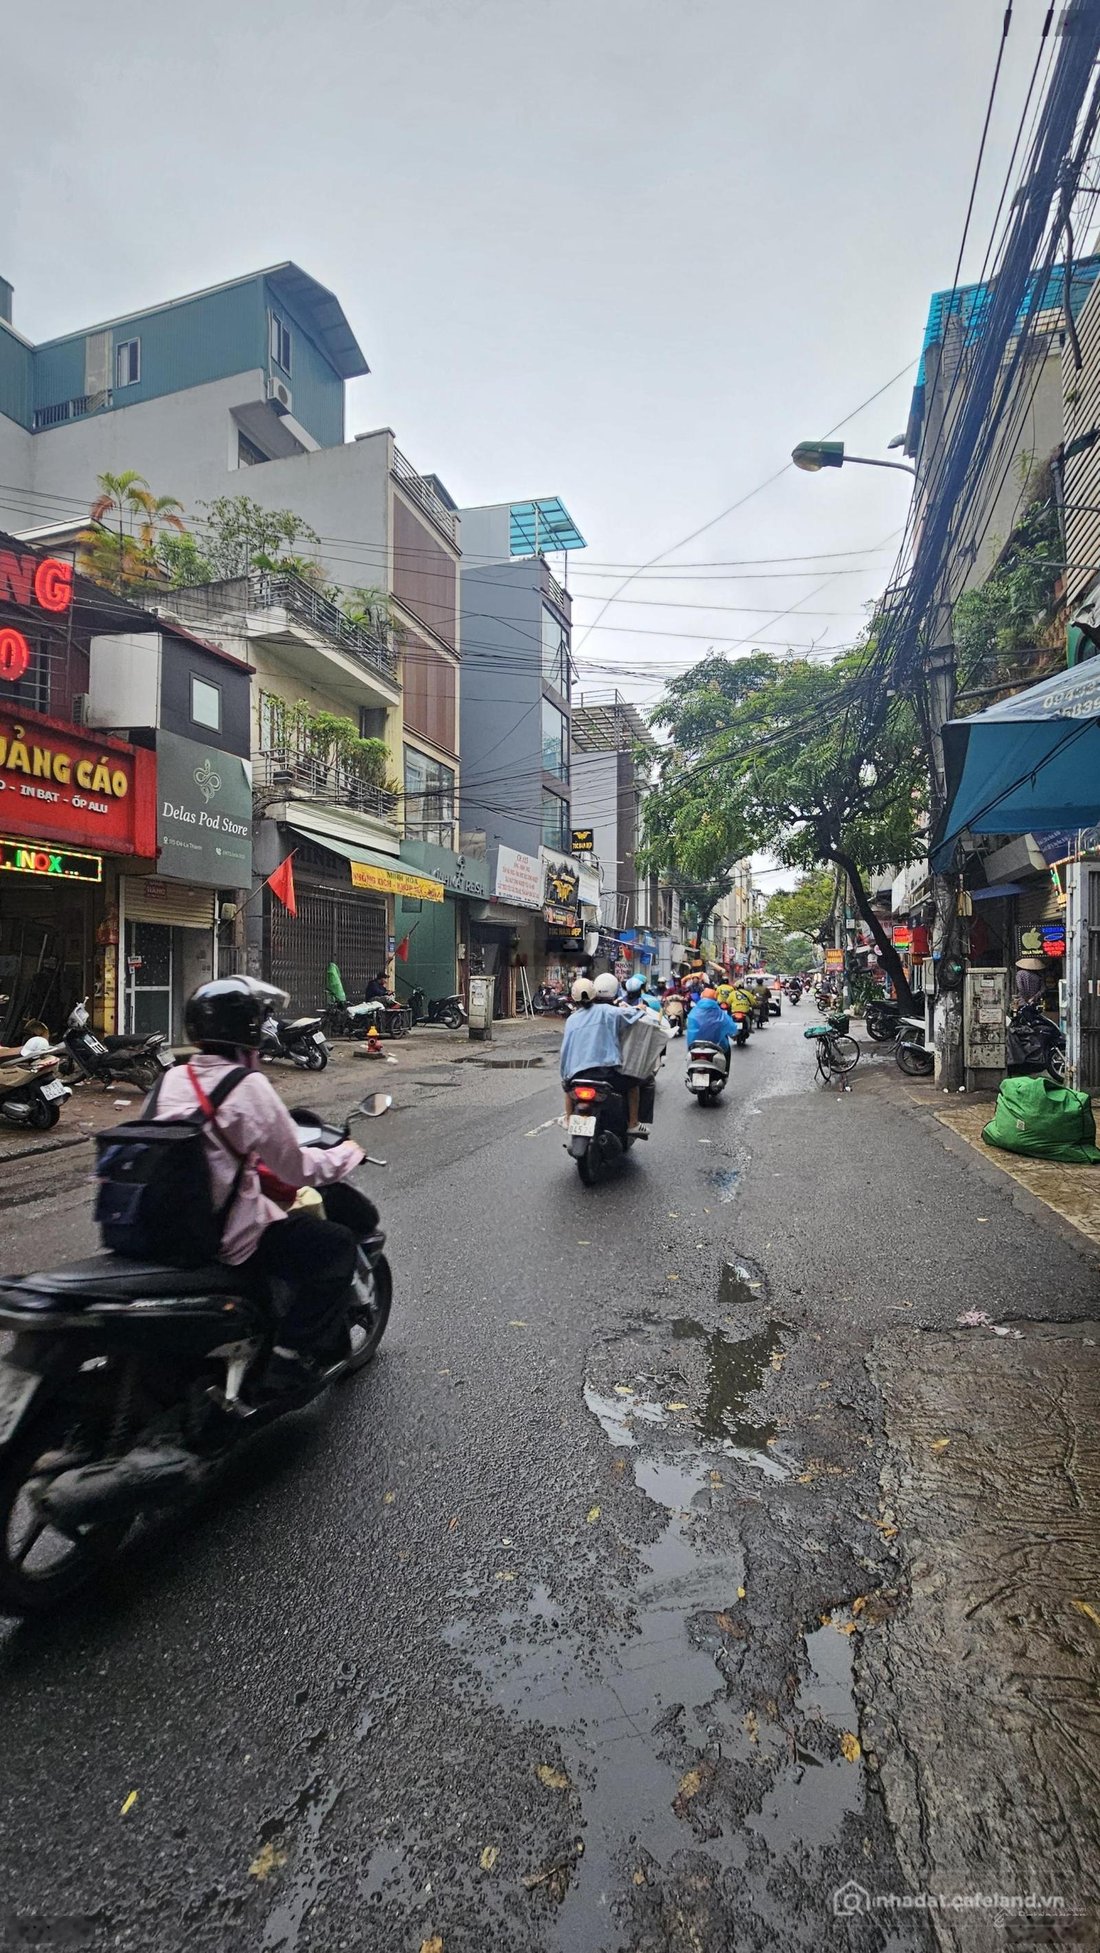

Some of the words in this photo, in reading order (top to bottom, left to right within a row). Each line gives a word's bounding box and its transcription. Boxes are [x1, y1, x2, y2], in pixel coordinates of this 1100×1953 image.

[76, 756, 128, 798] CÁO
[20, 784, 35, 797] IN
[36, 788, 60, 803] BẠT
[72, 794, 87, 808] ỐP
[88, 802, 108, 814] ALU
[162, 801, 197, 824] Delas
[198, 811, 220, 830] Pod
[221, 817, 248, 836] Store
